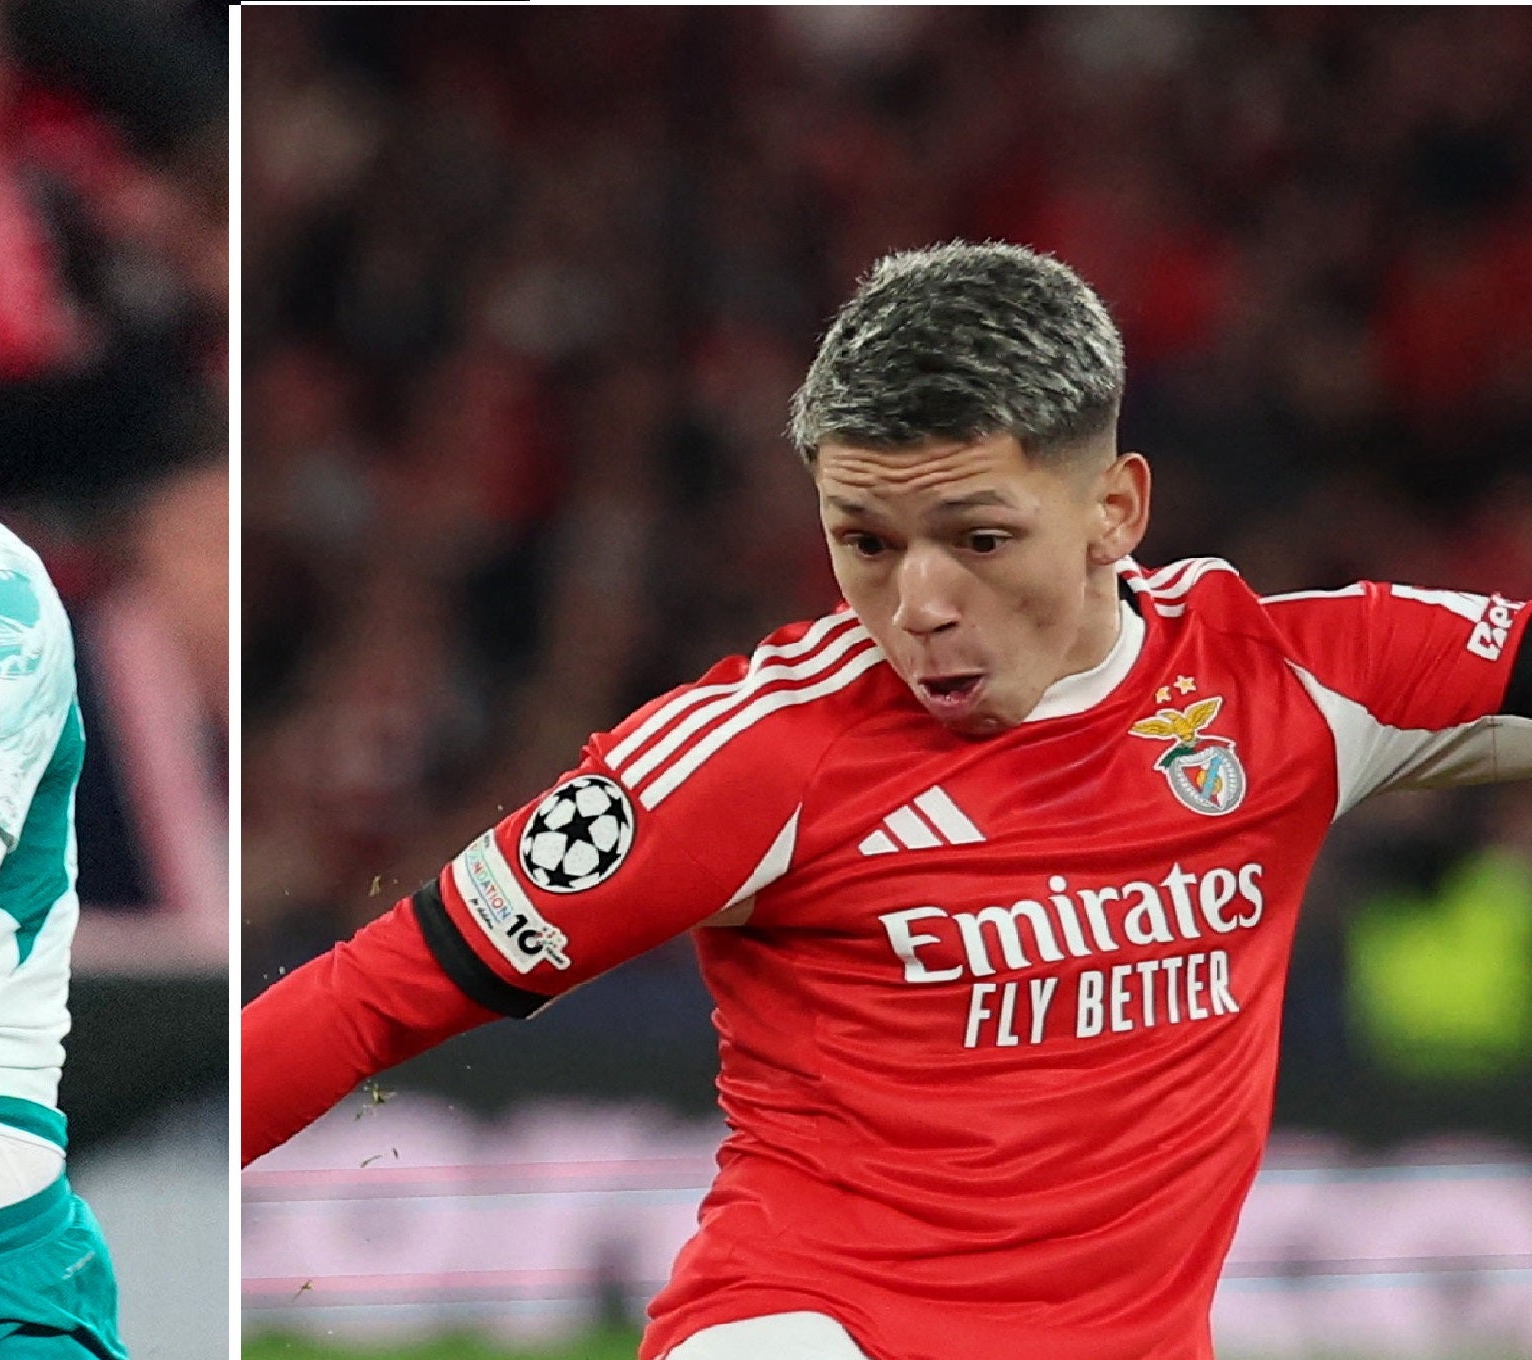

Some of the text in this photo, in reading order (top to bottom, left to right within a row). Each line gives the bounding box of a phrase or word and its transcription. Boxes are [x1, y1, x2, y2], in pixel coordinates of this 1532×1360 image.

[878, 862, 1264, 983] Emirates
[964, 950, 1240, 1048] FLY BETTER
